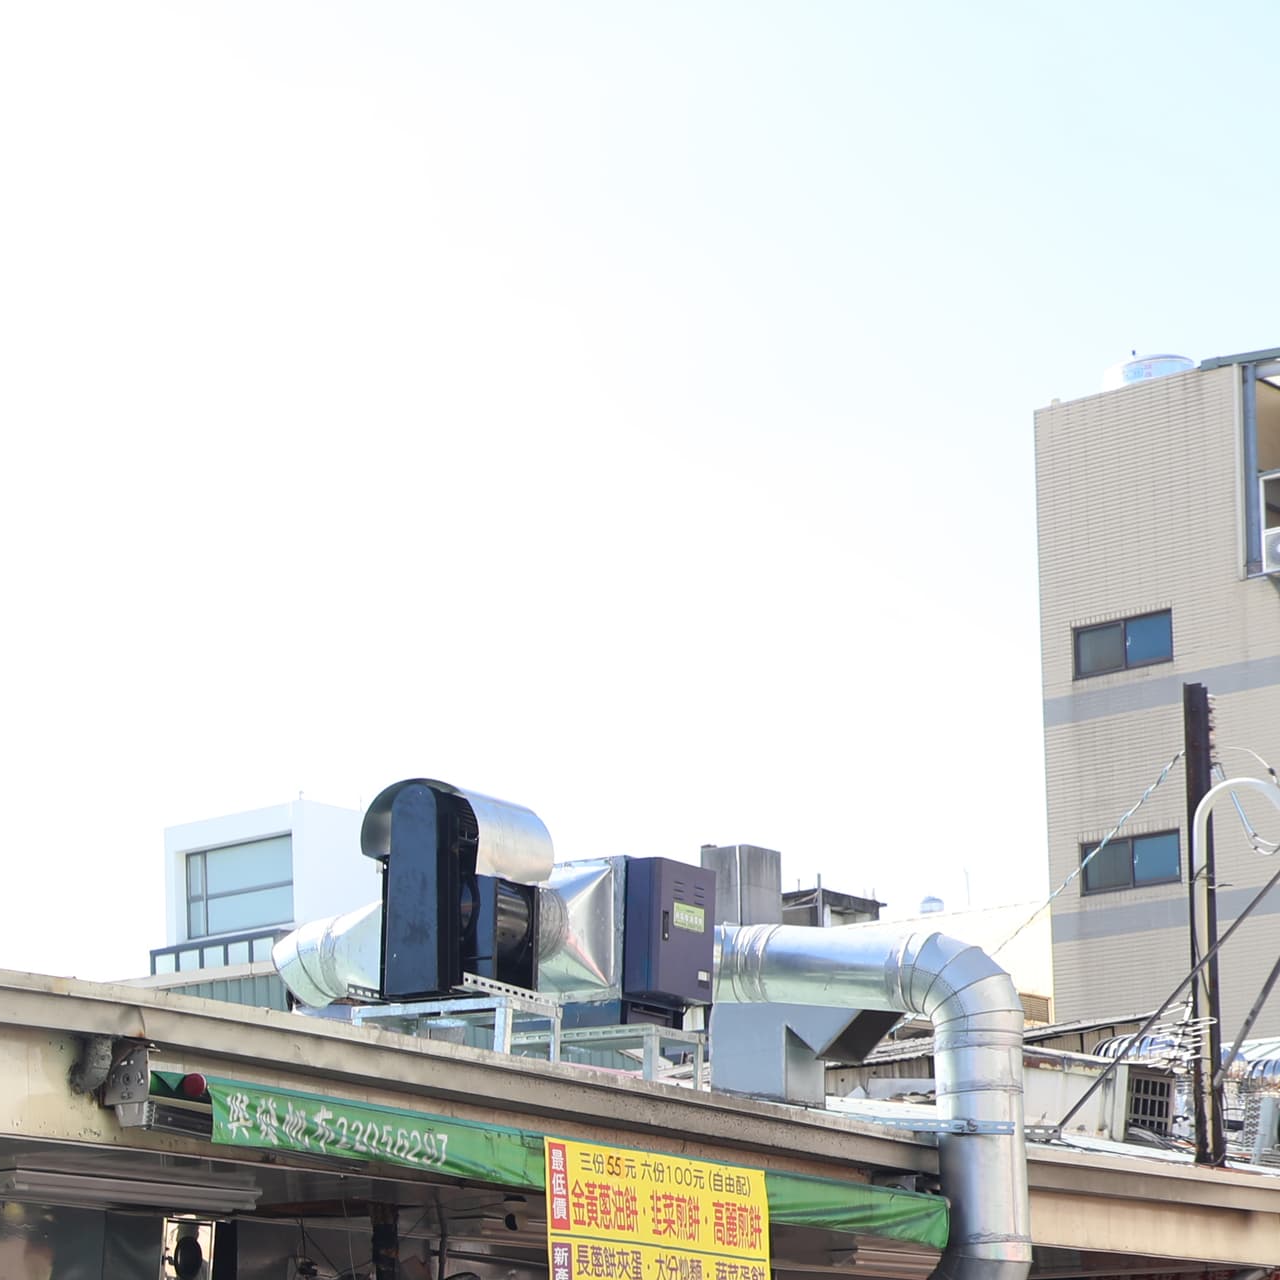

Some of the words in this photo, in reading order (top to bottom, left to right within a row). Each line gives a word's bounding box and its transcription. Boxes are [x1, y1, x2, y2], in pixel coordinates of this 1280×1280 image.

[551, 1148, 568, 1221] 最低價
[579, 1152, 637, 1180] 三份55元
[641, 1161, 705, 1190] 六份100元
